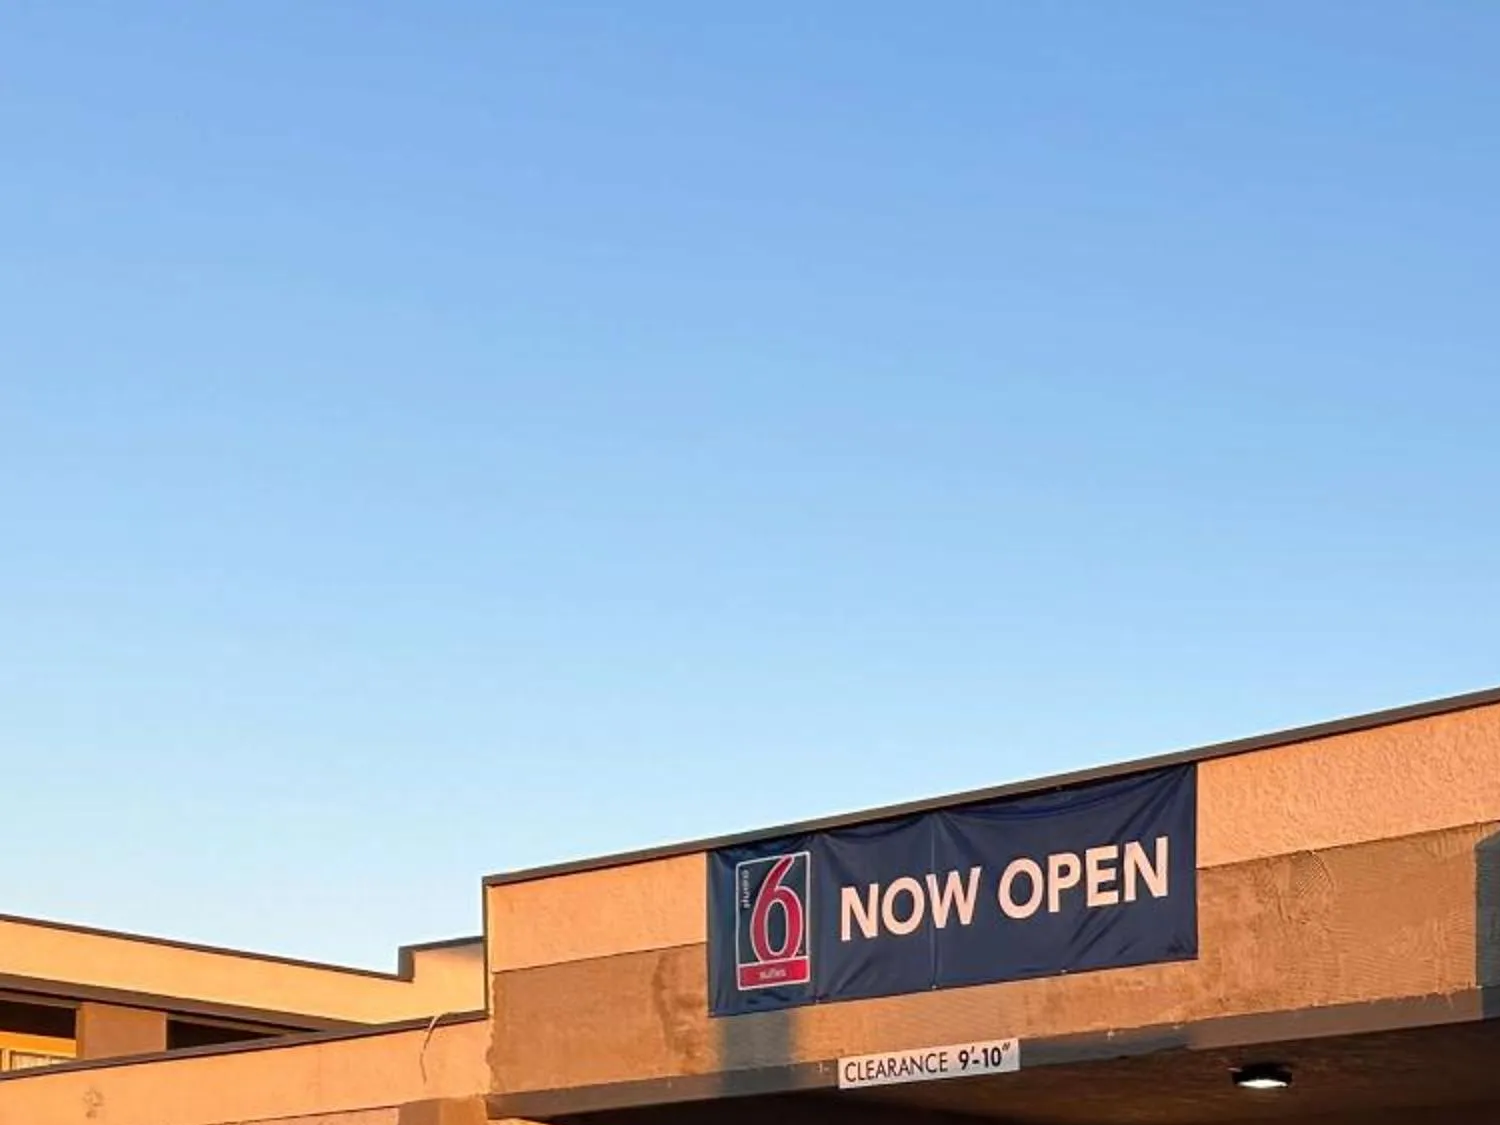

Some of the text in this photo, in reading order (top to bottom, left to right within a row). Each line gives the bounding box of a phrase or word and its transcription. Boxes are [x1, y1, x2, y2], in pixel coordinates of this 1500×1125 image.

[749, 853, 804, 963] 6
[840, 866, 982, 941] NOW
[998, 836, 1169, 919] OPEN
[845, 1051, 948, 1083] CLEARANCE
